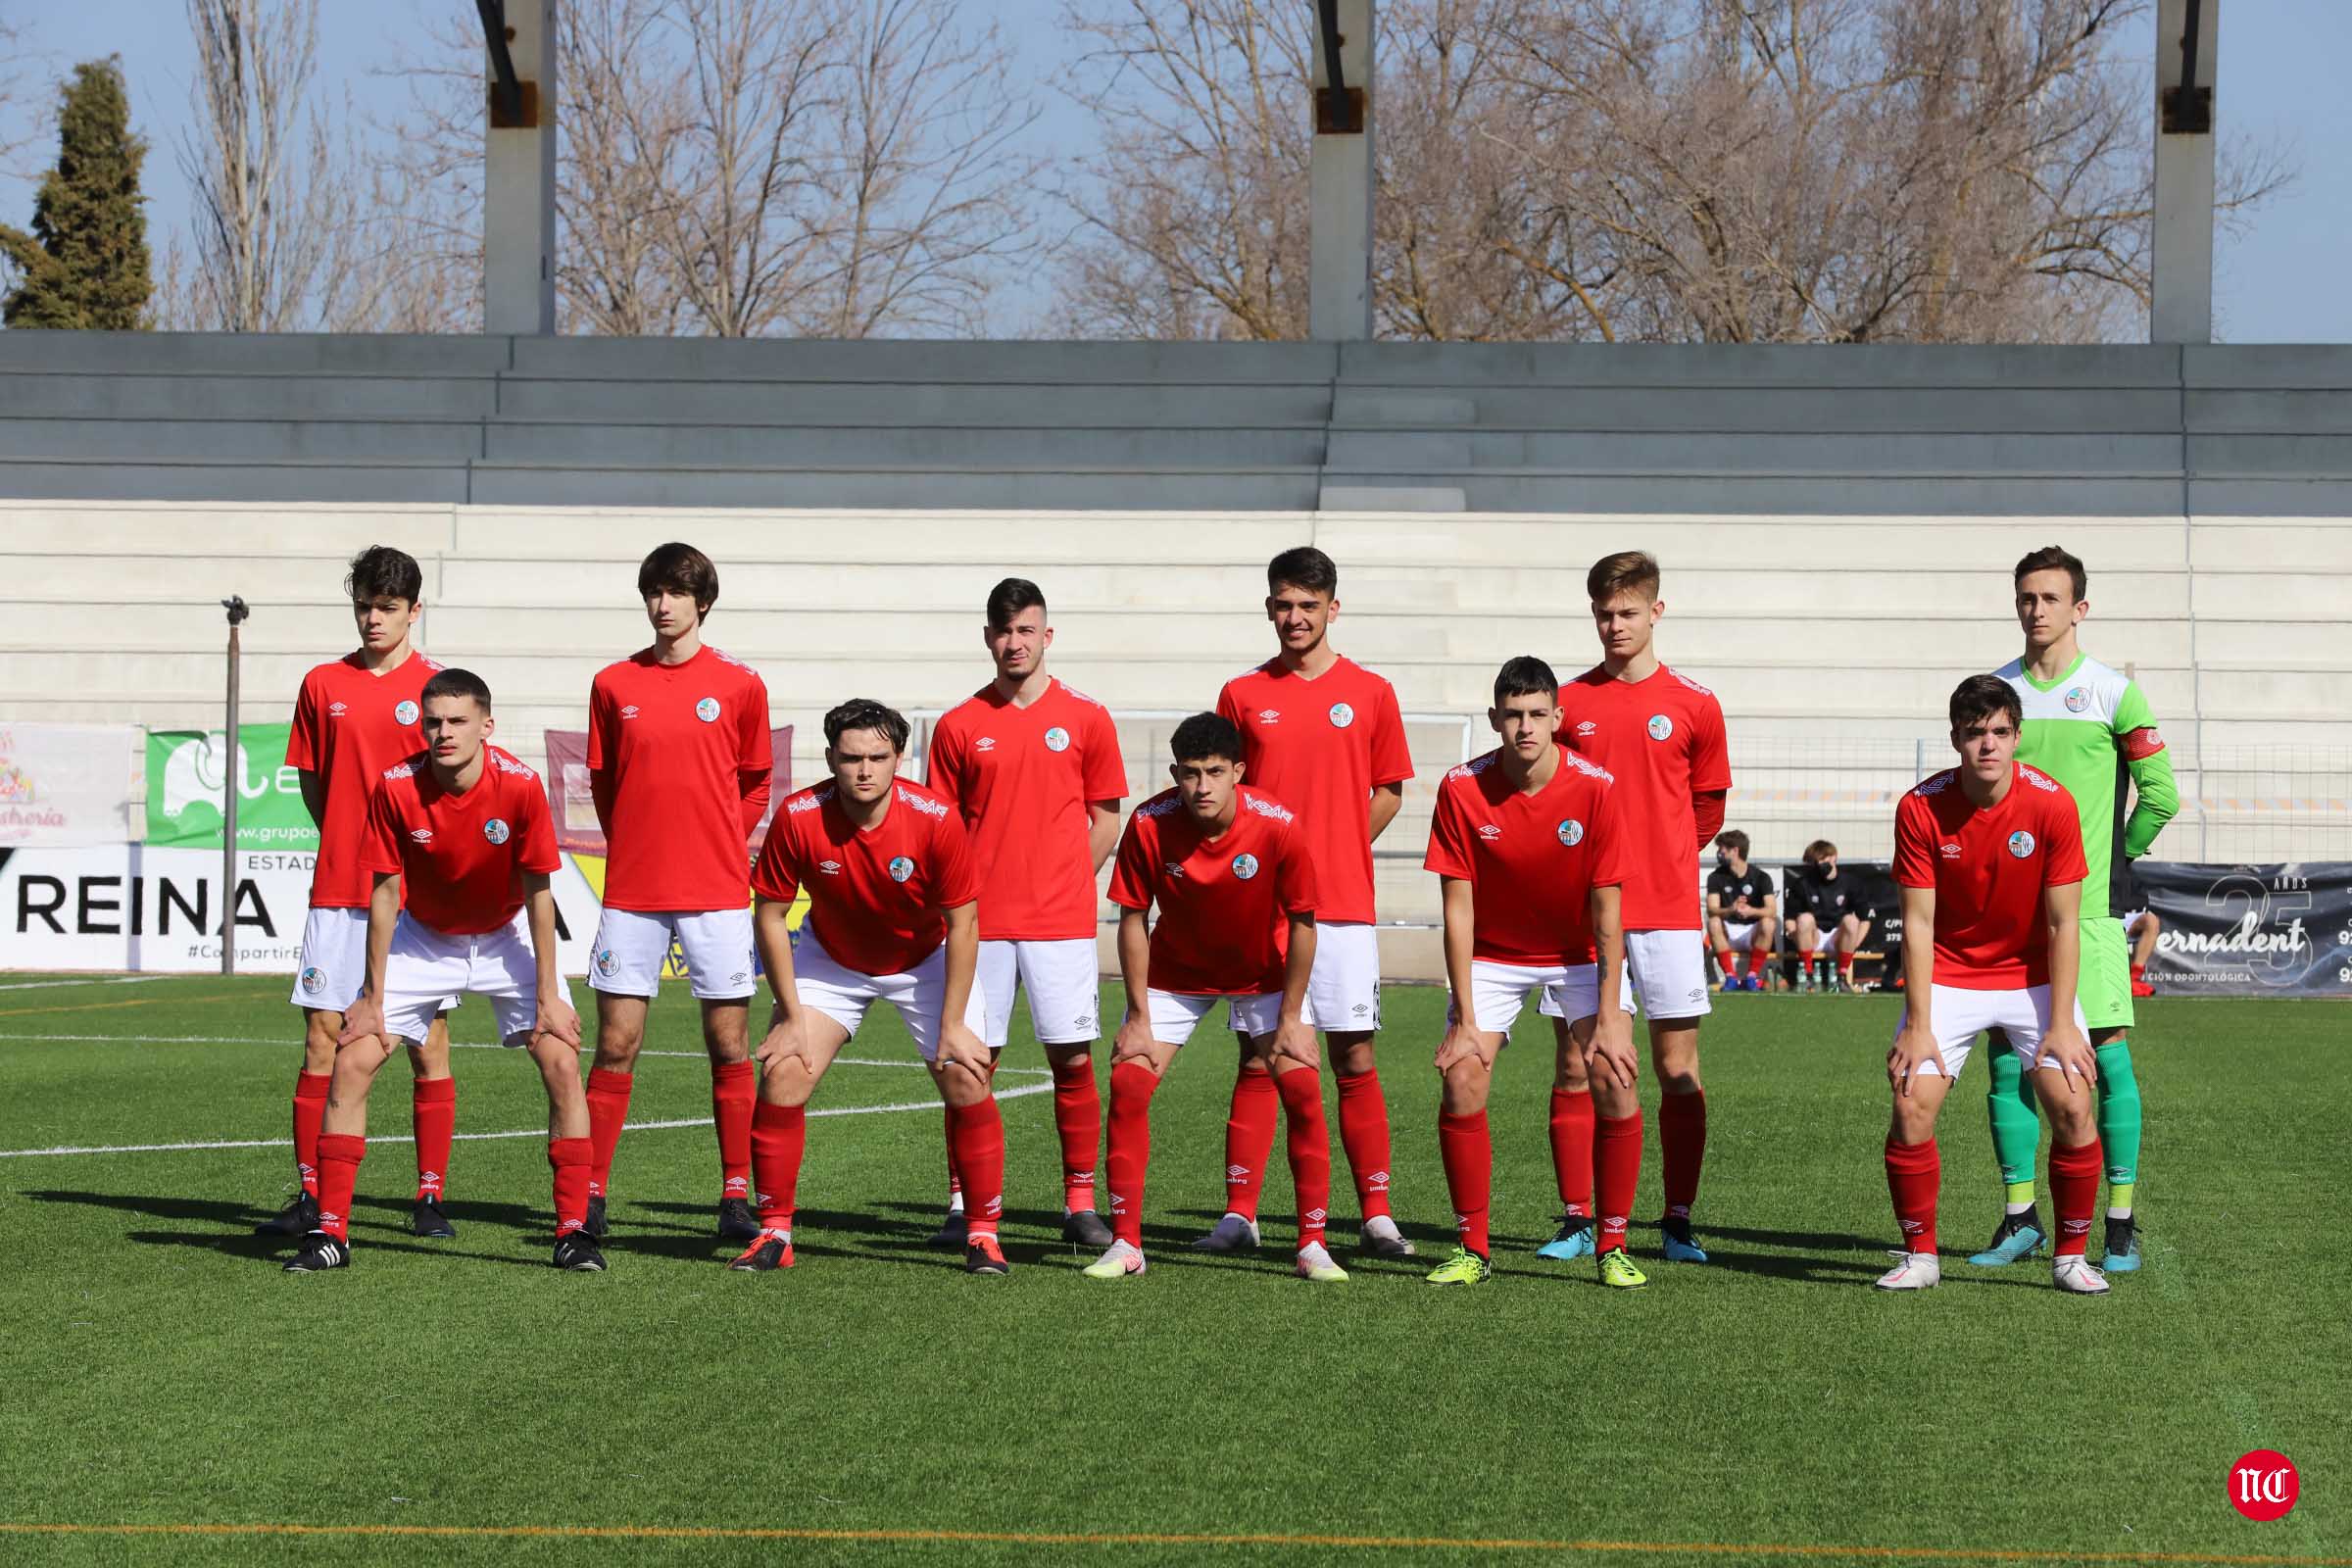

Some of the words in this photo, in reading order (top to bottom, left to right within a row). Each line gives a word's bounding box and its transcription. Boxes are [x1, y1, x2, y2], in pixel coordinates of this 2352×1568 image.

[17, 875, 278, 938] REINA
[2156, 910, 2306, 954] ernadent
[2338, 930, 2352, 946] 9
[2339, 967, 2352, 983] 9
